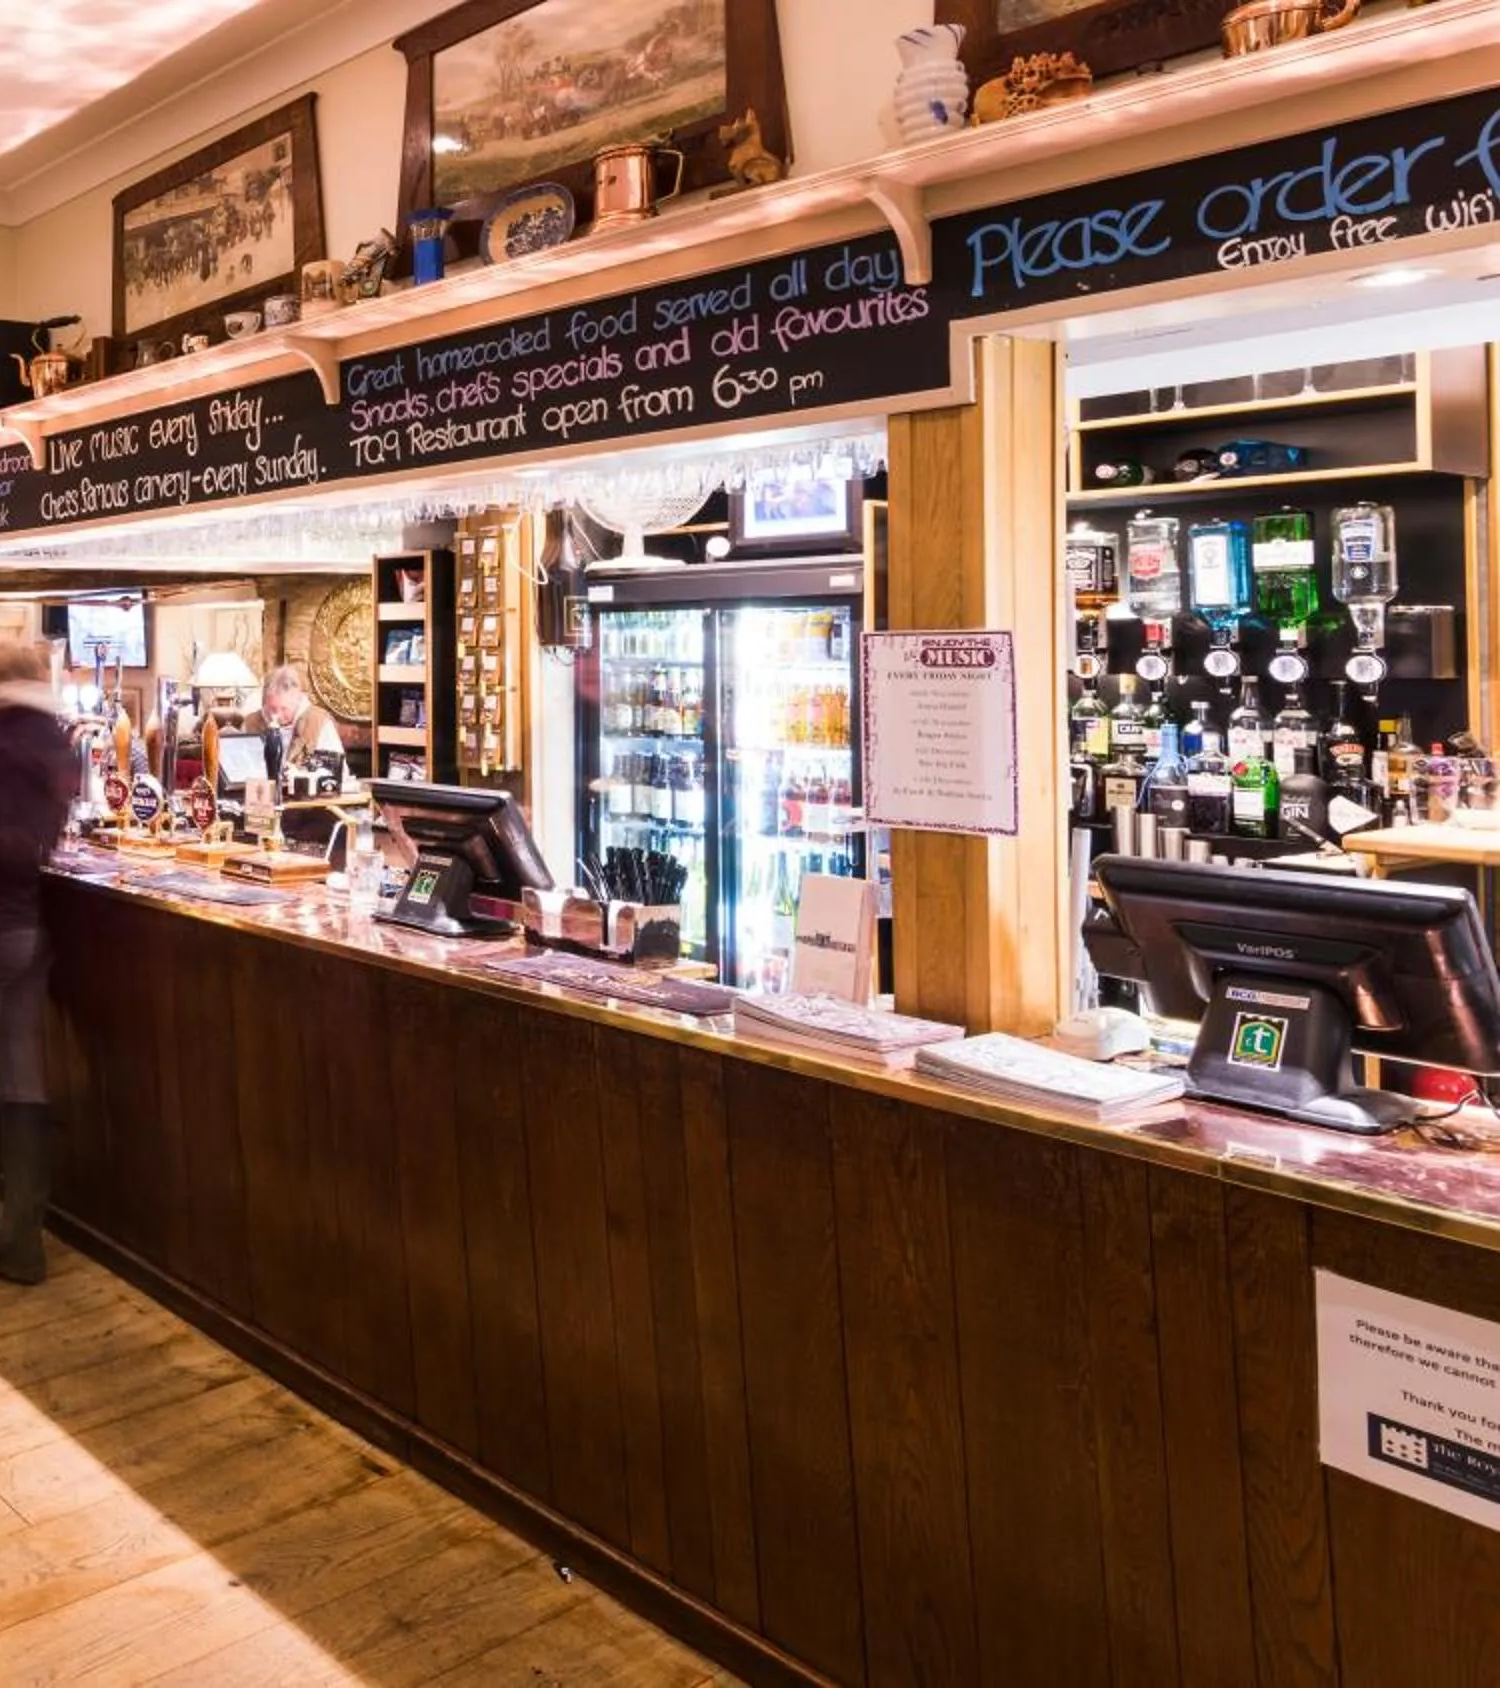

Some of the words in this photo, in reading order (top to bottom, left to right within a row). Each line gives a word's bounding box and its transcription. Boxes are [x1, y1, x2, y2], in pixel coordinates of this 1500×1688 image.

[966, 200, 1171, 296] Please
[1197, 136, 1445, 239] order
[1217, 233, 1306, 270] Enjoy
[1329, 215, 1397, 250] free
[347, 355, 405, 397] Great
[565, 296, 637, 350] food
[652, 273, 751, 331] served
[769, 259, 808, 301] all
[825, 247, 899, 293] day
[511, 345, 623, 401] specials
[635, 326, 691, 371] and
[711, 314, 760, 357] old
[770, 288, 929, 352] favourites
[349, 429, 401, 468] TQ9
[406, 404, 527, 456] Restaurant
[541, 397, 609, 439] open
[618, 384, 693, 423] from
[789, 369, 823, 406] pm
[50, 440, 83, 475] Live
[150, 412, 199, 456] every
[80, 477, 130, 514] famous
[926, 648, 992, 666] MUSIC
[966, 638, 991, 647] THE
[1281, 802, 1310, 819] GIN
[1237, 943, 1295, 959] VariPOS
[1349, 1334, 1414, 1362] therefore
[1419, 1357, 1440, 1370] we
[1443, 1365, 1496, 1388] cannot
[1356, 1319, 1401, 1341] Please
[1403, 1333, 1421, 1346] be
[1425, 1343, 1471, 1362] aware
[1400, 1389, 1445, 1412] Thank
[1448, 1407, 1477, 1424] you
[1454, 1427, 1483, 1446] The
